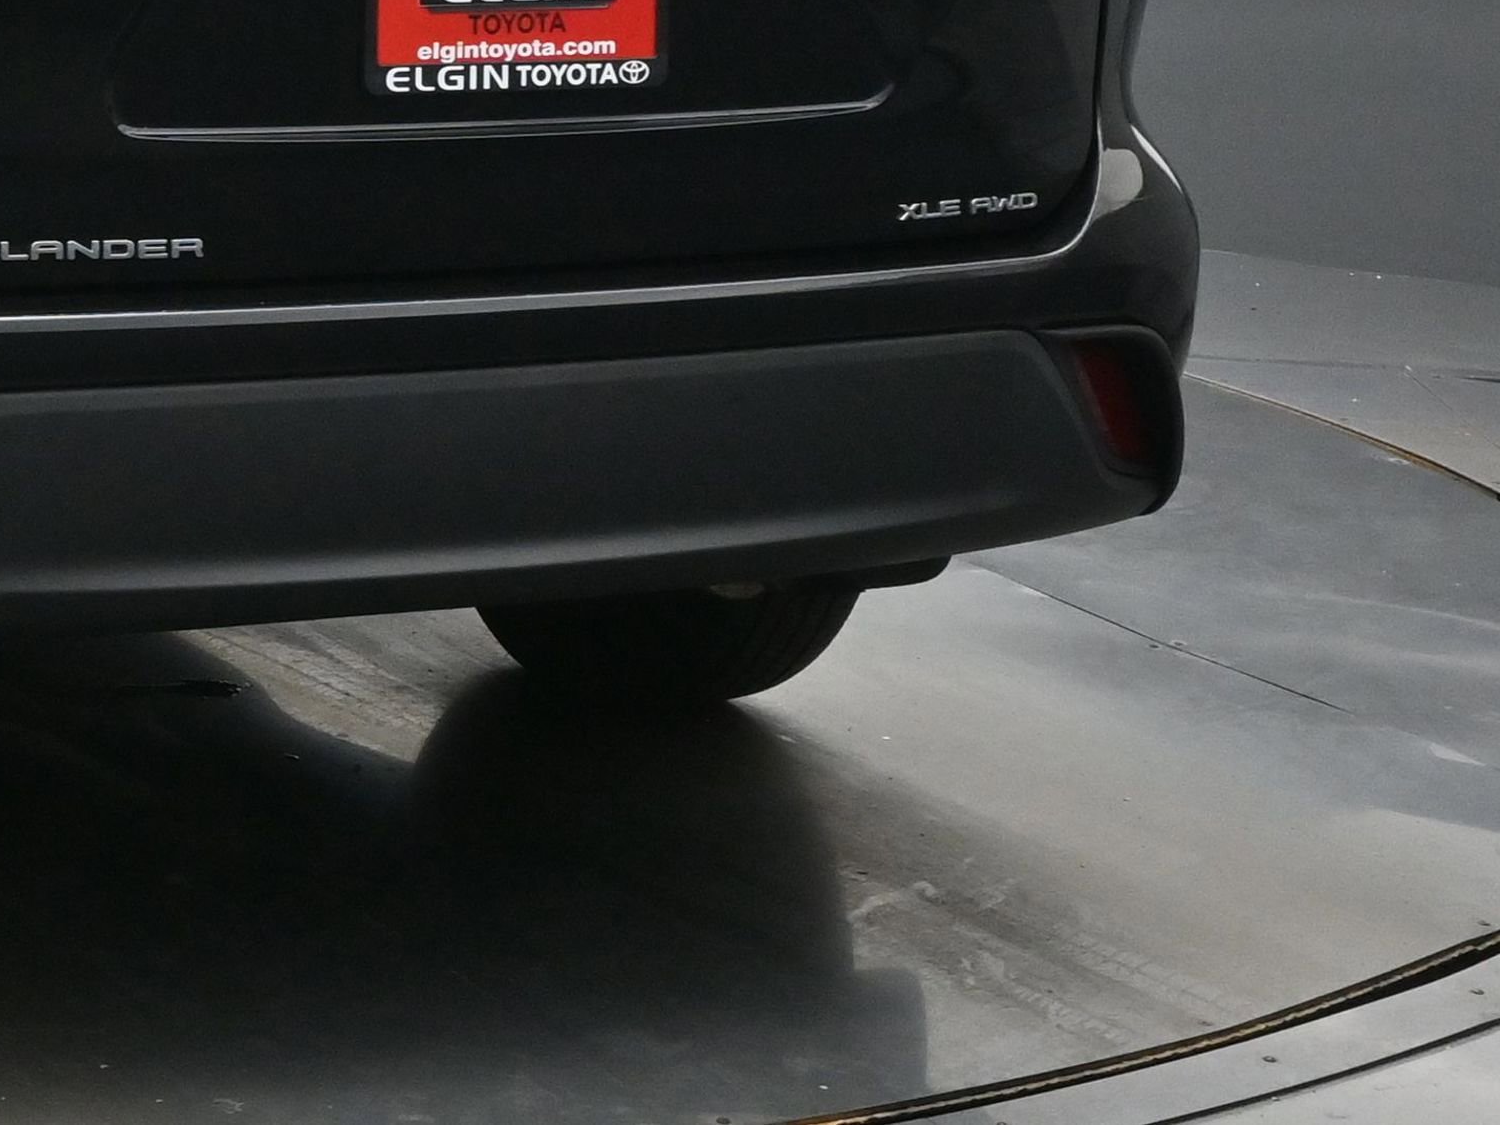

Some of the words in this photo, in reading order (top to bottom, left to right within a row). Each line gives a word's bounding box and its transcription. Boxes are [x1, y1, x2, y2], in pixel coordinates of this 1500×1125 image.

[469, 13, 566, 35] TOYOTA
[417, 40, 615, 63] elgintoyota.com
[385, 64, 509, 92] ELGIN
[516, 63, 618, 87] TOYOTA
[897, 198, 962, 221] XLE
[970, 192, 1038, 215] AWD
